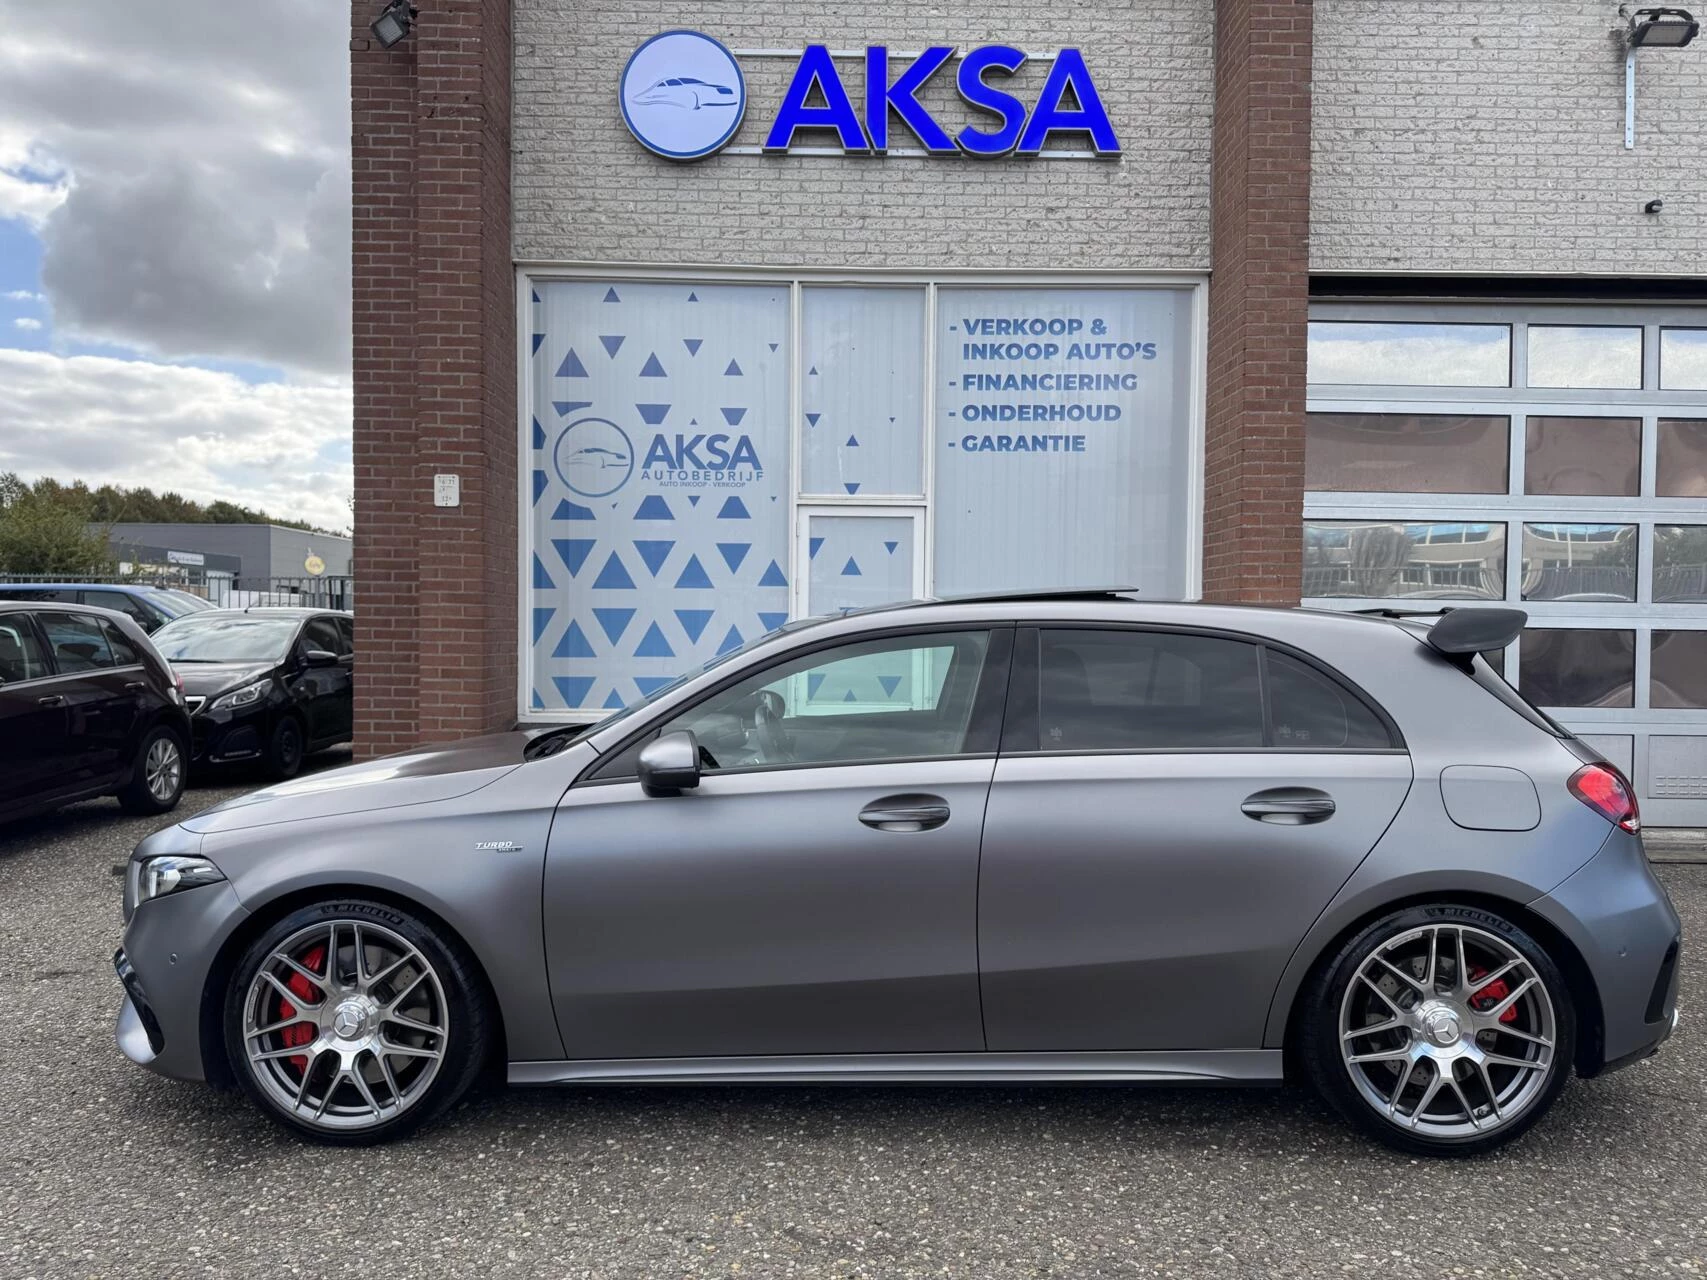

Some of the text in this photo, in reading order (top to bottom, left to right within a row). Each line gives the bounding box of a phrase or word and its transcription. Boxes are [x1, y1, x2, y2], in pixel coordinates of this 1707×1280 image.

[761, 44, 1122, 159] AKSA
[962, 318, 1083, 336] VERKOOP
[1090, 318, 1107, 336] &
[963, 341, 1157, 360] INKOOP AUTO'S
[962, 373, 1138, 391] FINANCIERING
[962, 404, 1121, 421] ONDERHOUD
[642, 433, 763, 471] AKSA
[961, 435, 1086, 452] GARANTIE
[641, 470, 764, 482] AUTOBEDRIJF
[475, 841, 513, 849] TURBO
[337, 904, 401, 923] MICHELIN
[1444, 908, 1510, 930] MICHELIN
